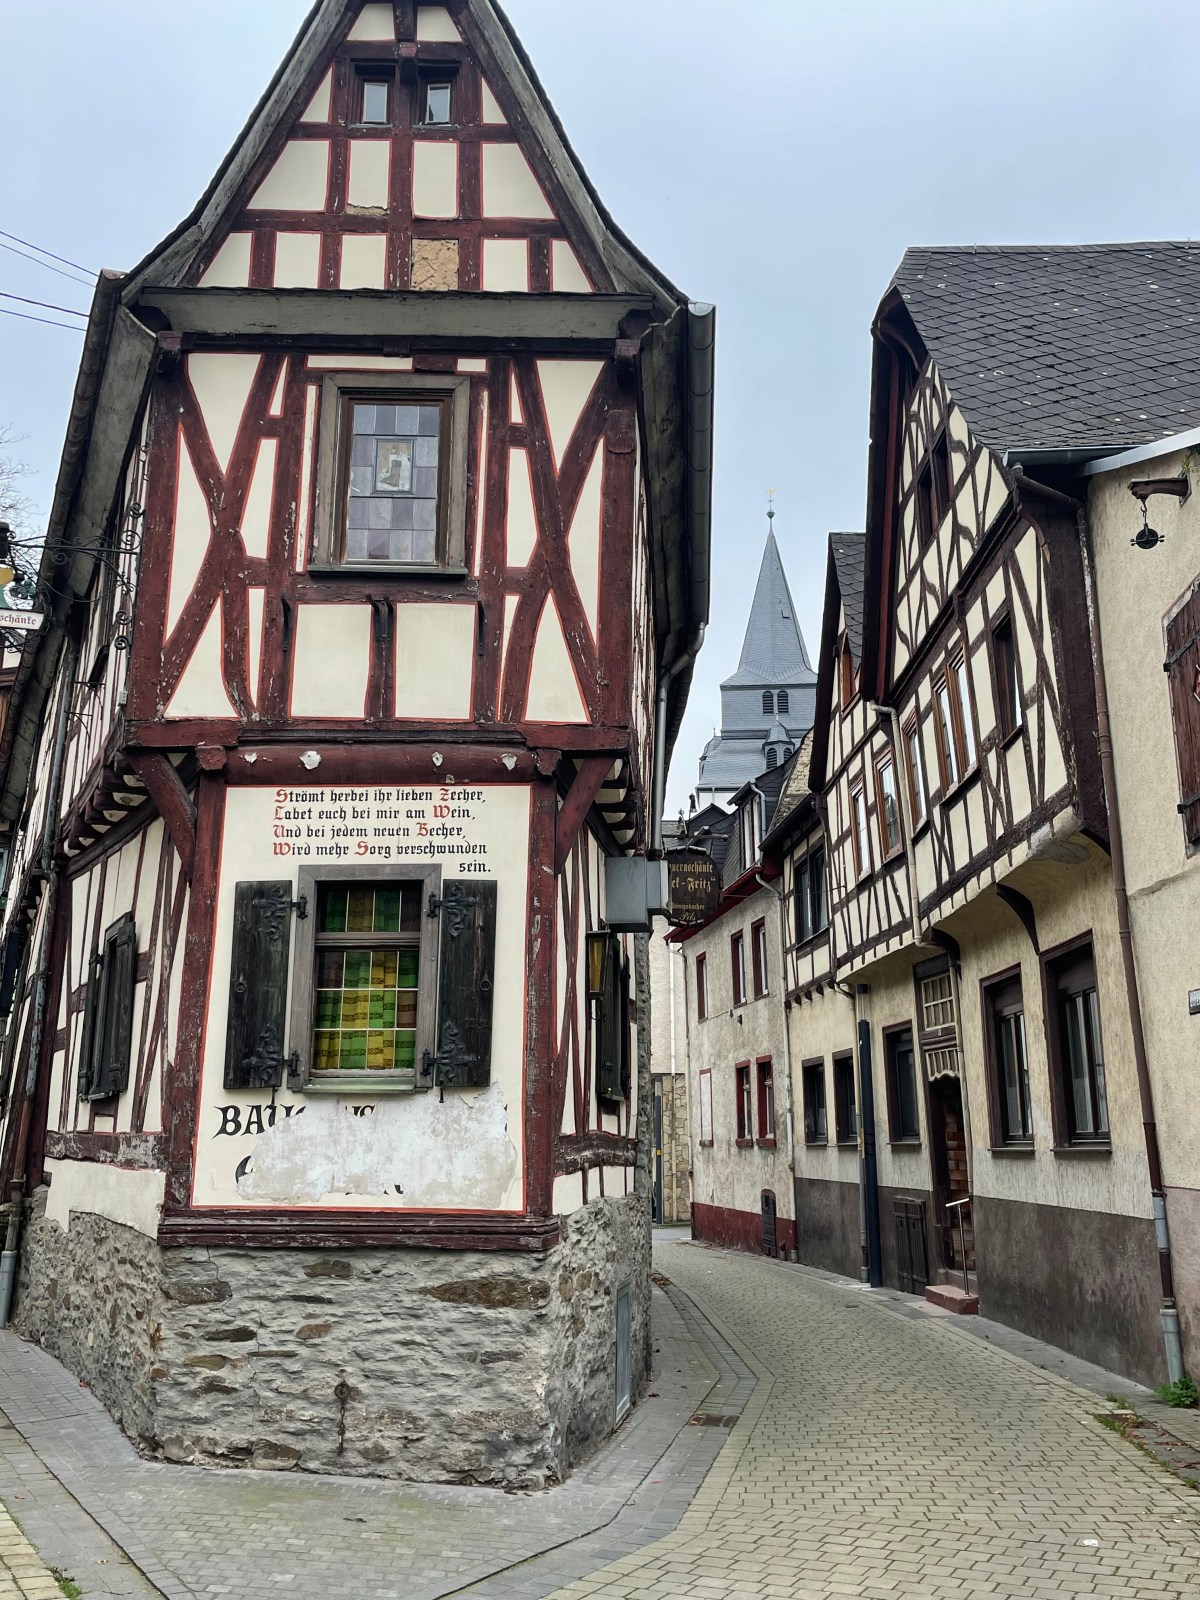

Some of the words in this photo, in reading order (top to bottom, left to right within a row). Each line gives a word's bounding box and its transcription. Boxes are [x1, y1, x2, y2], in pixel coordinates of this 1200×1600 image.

[274, 788, 326, 804] Strömt
[329, 788, 370, 805] herbei
[373, 788, 393, 805] ihr
[396, 787, 433, 802] lieben
[439, 787, 486, 805] Zecher,
[273, 805, 313, 821] Labet
[318, 805, 347, 821] euch
[351, 805, 370, 820] bei
[376, 806, 400, 820] mir
[405, 807, 426, 819] am
[432, 804, 476, 821] Wein,
[272, 823, 302, 839] Und
[306, 824, 326, 839] bei
[329, 823, 369, 841] jedem
[373, 826, 410, 838] neuen
[415, 822, 467, 840] Becher,
[272, 841, 311, 857] Wird
[316, 842, 350, 859] mehr
[354, 840, 392, 859] Sorg
[396, 839, 488, 859] verschwunden
[458, 860, 492, 874] sein.
[670, 861, 713, 874] uernschänke
[679, 911, 697, 921] Pils
